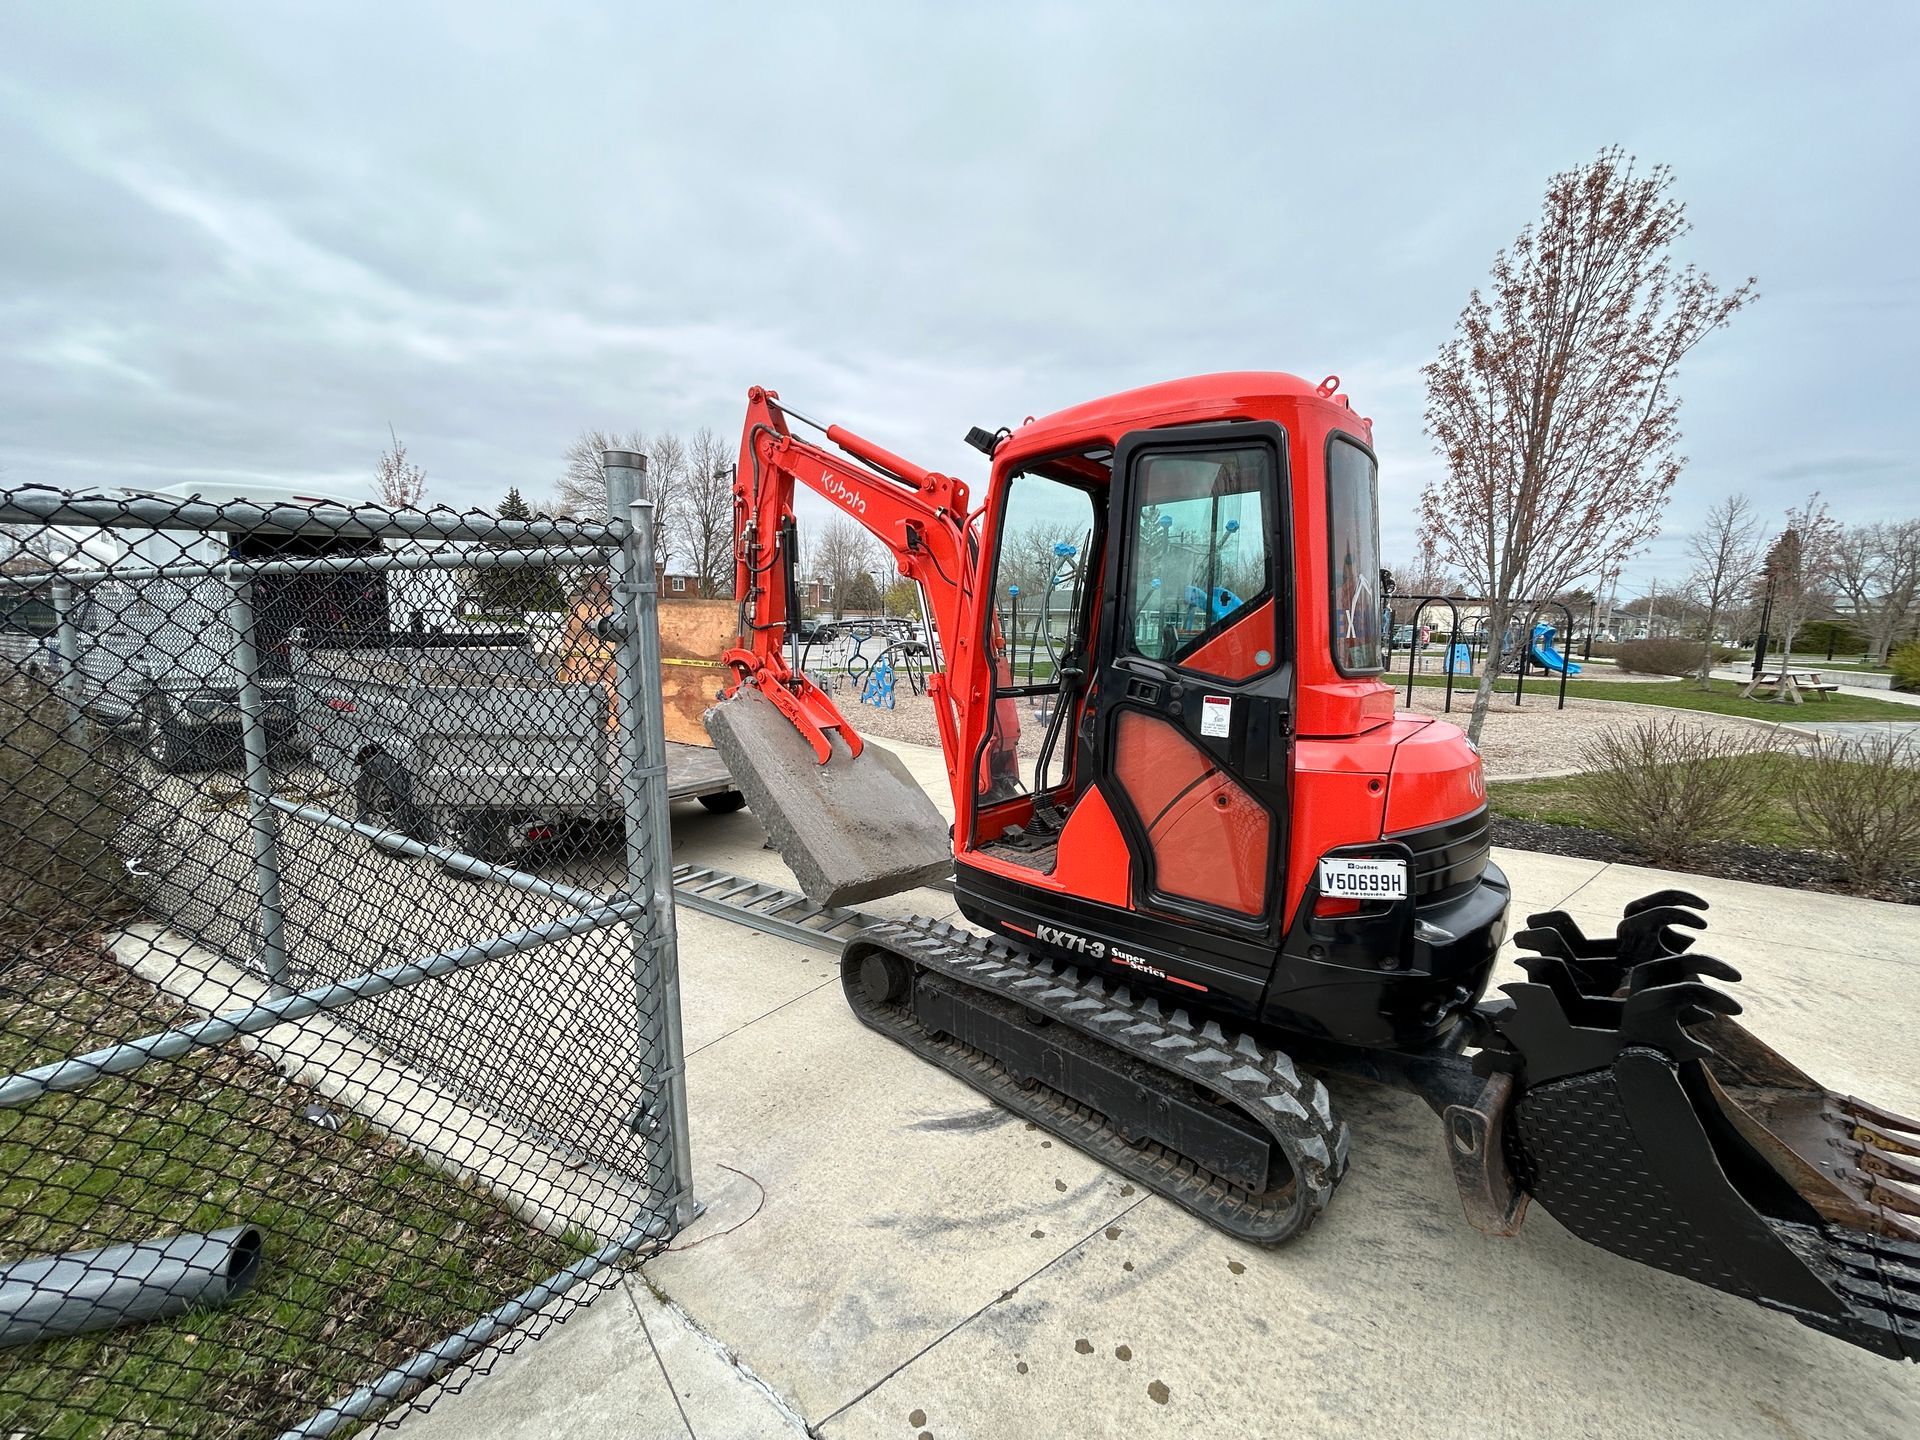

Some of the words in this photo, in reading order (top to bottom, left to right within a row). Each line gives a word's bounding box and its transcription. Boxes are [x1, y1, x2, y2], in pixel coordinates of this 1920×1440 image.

[821, 470, 867, 514] Kubota
[1326, 873, 1401, 892] V50699H
[1036, 924, 1106, 959] KX71-3
[1111, 947, 1146, 964] Super
[1130, 961, 1166, 979] Series
